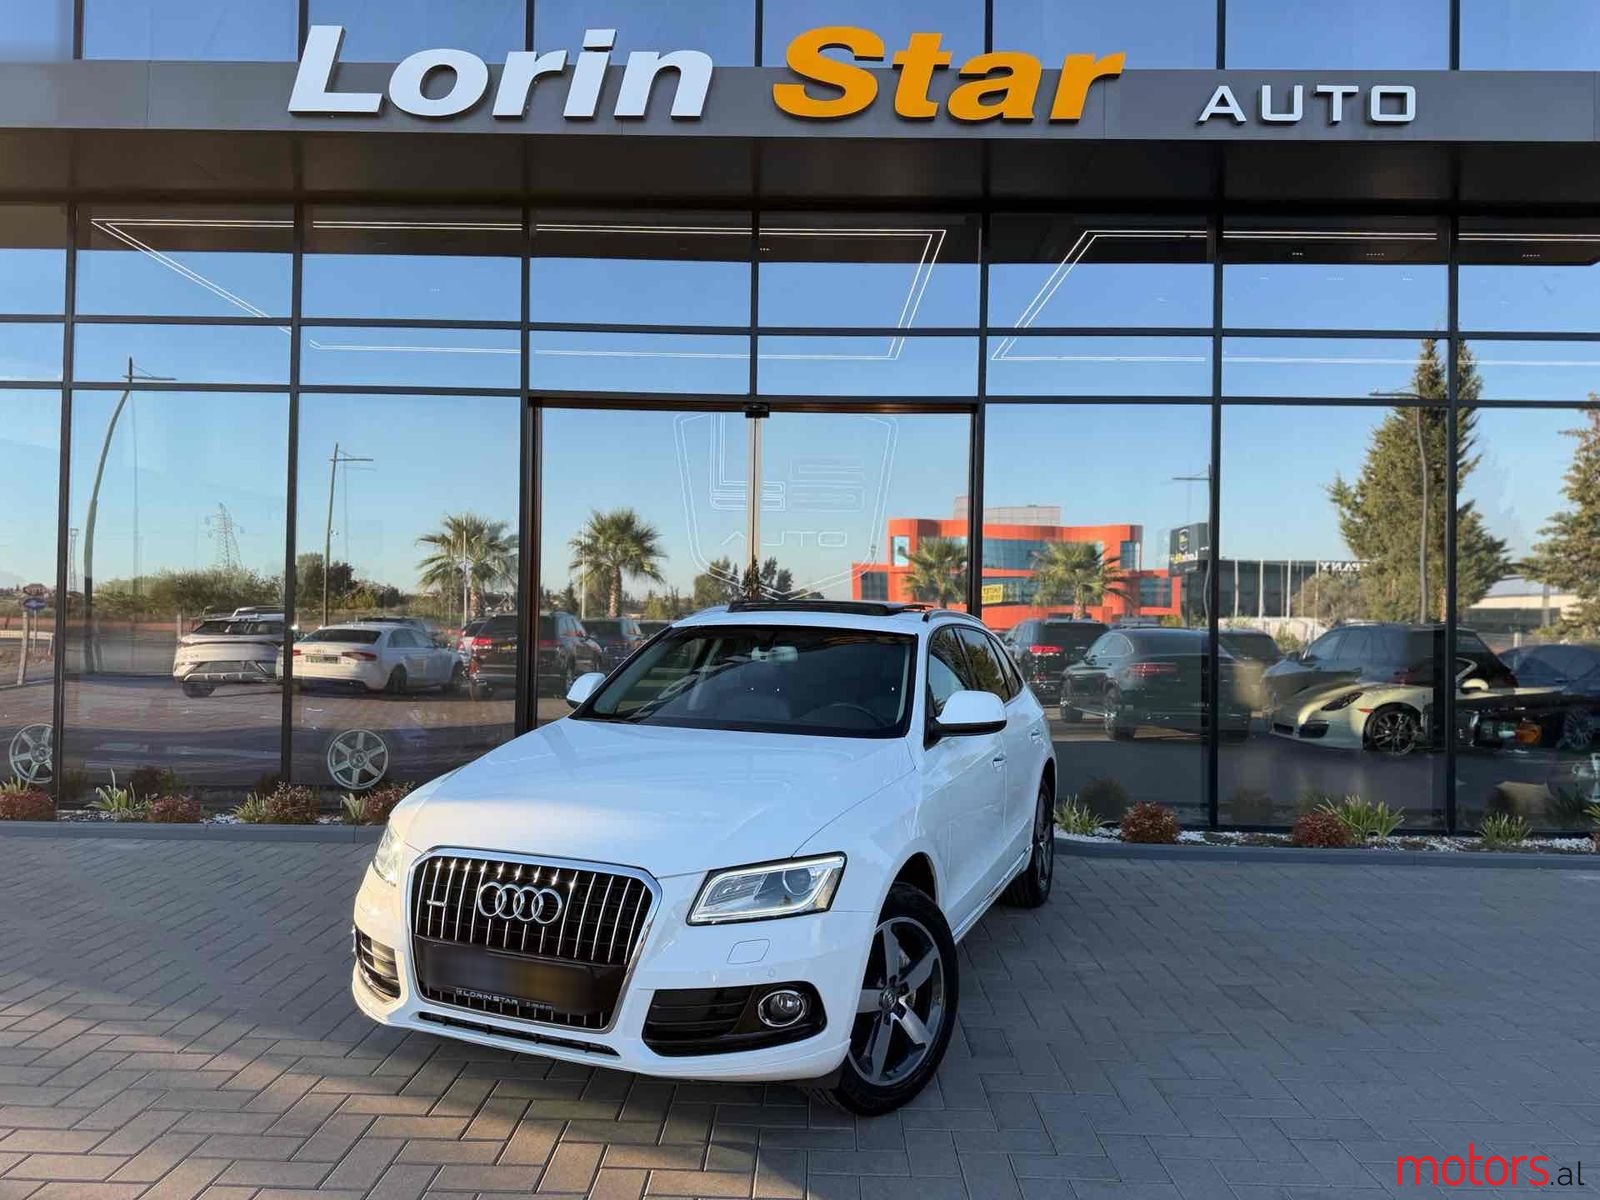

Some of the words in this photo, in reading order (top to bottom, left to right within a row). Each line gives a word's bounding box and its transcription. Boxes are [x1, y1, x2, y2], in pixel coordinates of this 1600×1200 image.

[288, 25, 713, 119] Lorin
[772, 26, 1126, 124] Star
[1196, 85, 1418, 126] AUTO
